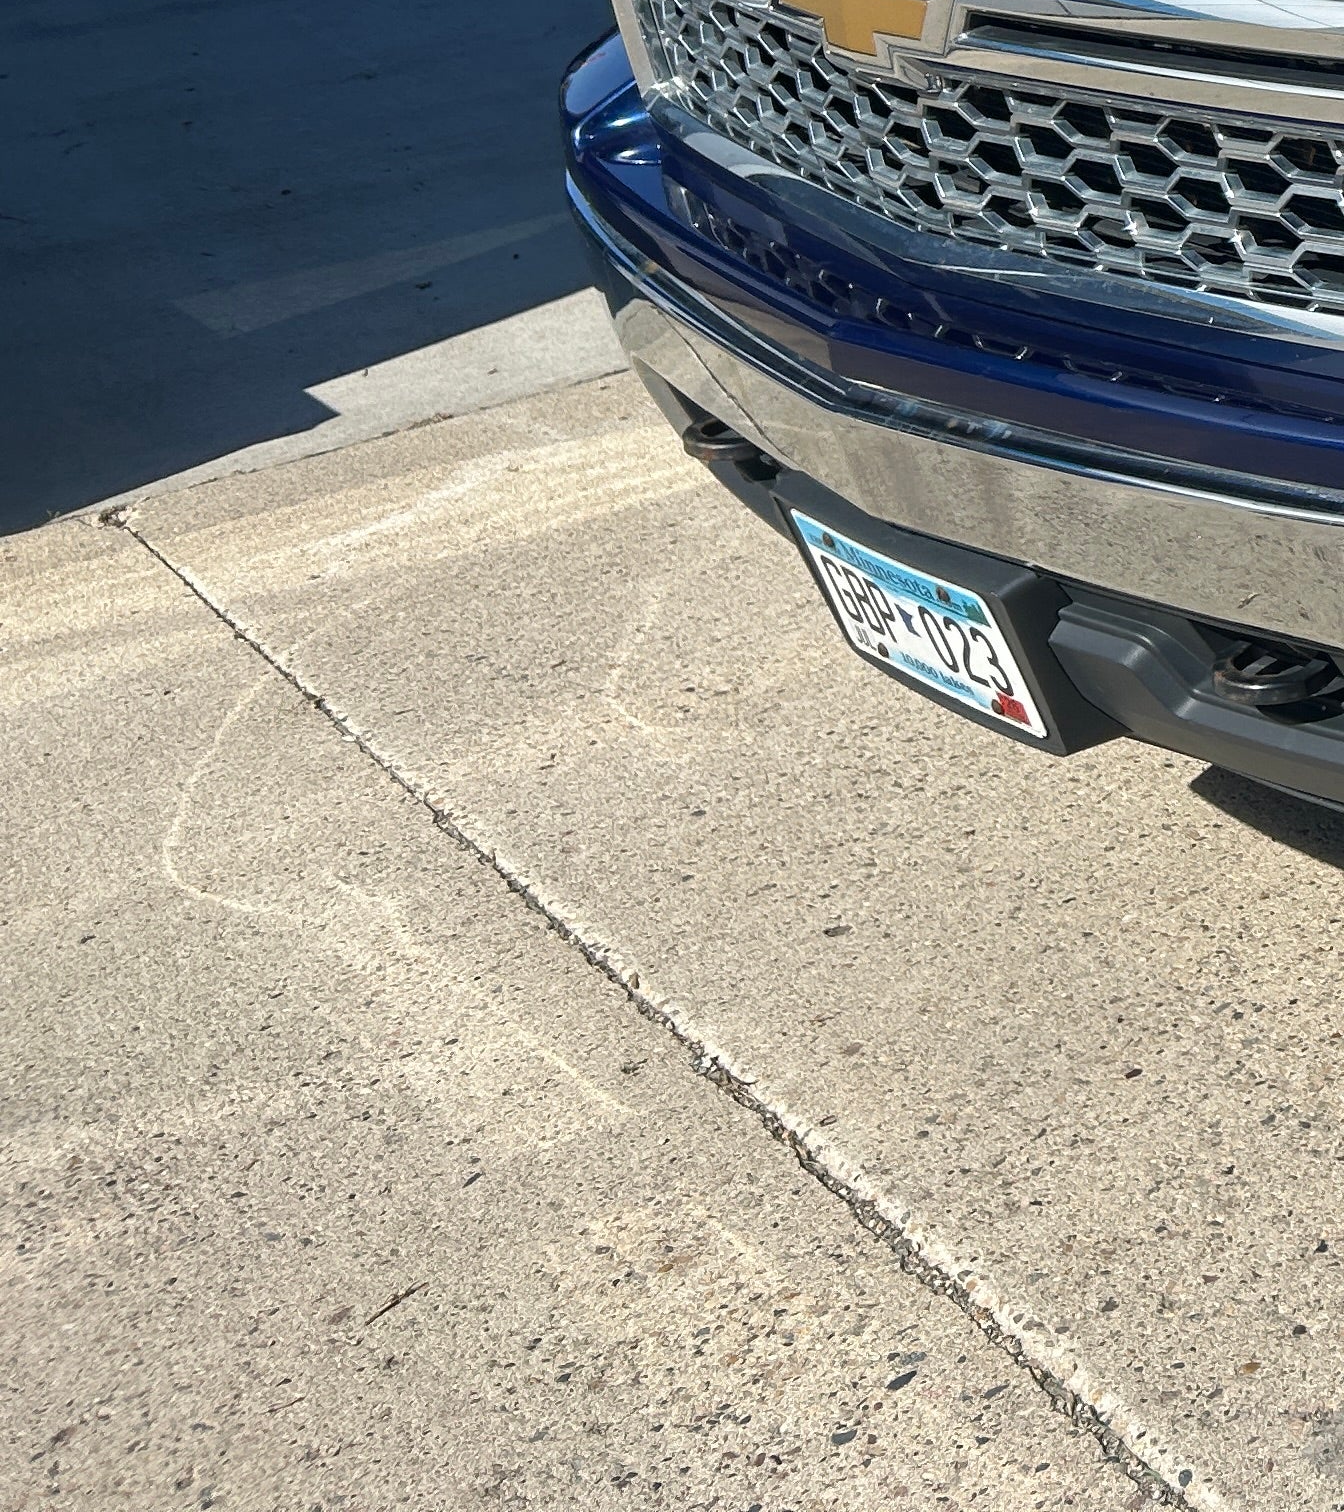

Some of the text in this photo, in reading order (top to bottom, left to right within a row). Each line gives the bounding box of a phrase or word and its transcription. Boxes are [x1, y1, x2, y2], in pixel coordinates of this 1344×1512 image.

[839, 539, 935, 601] Minnesota
[820, 554, 1015, 696] GBP 023
[855, 624, 878, 651] JUL
